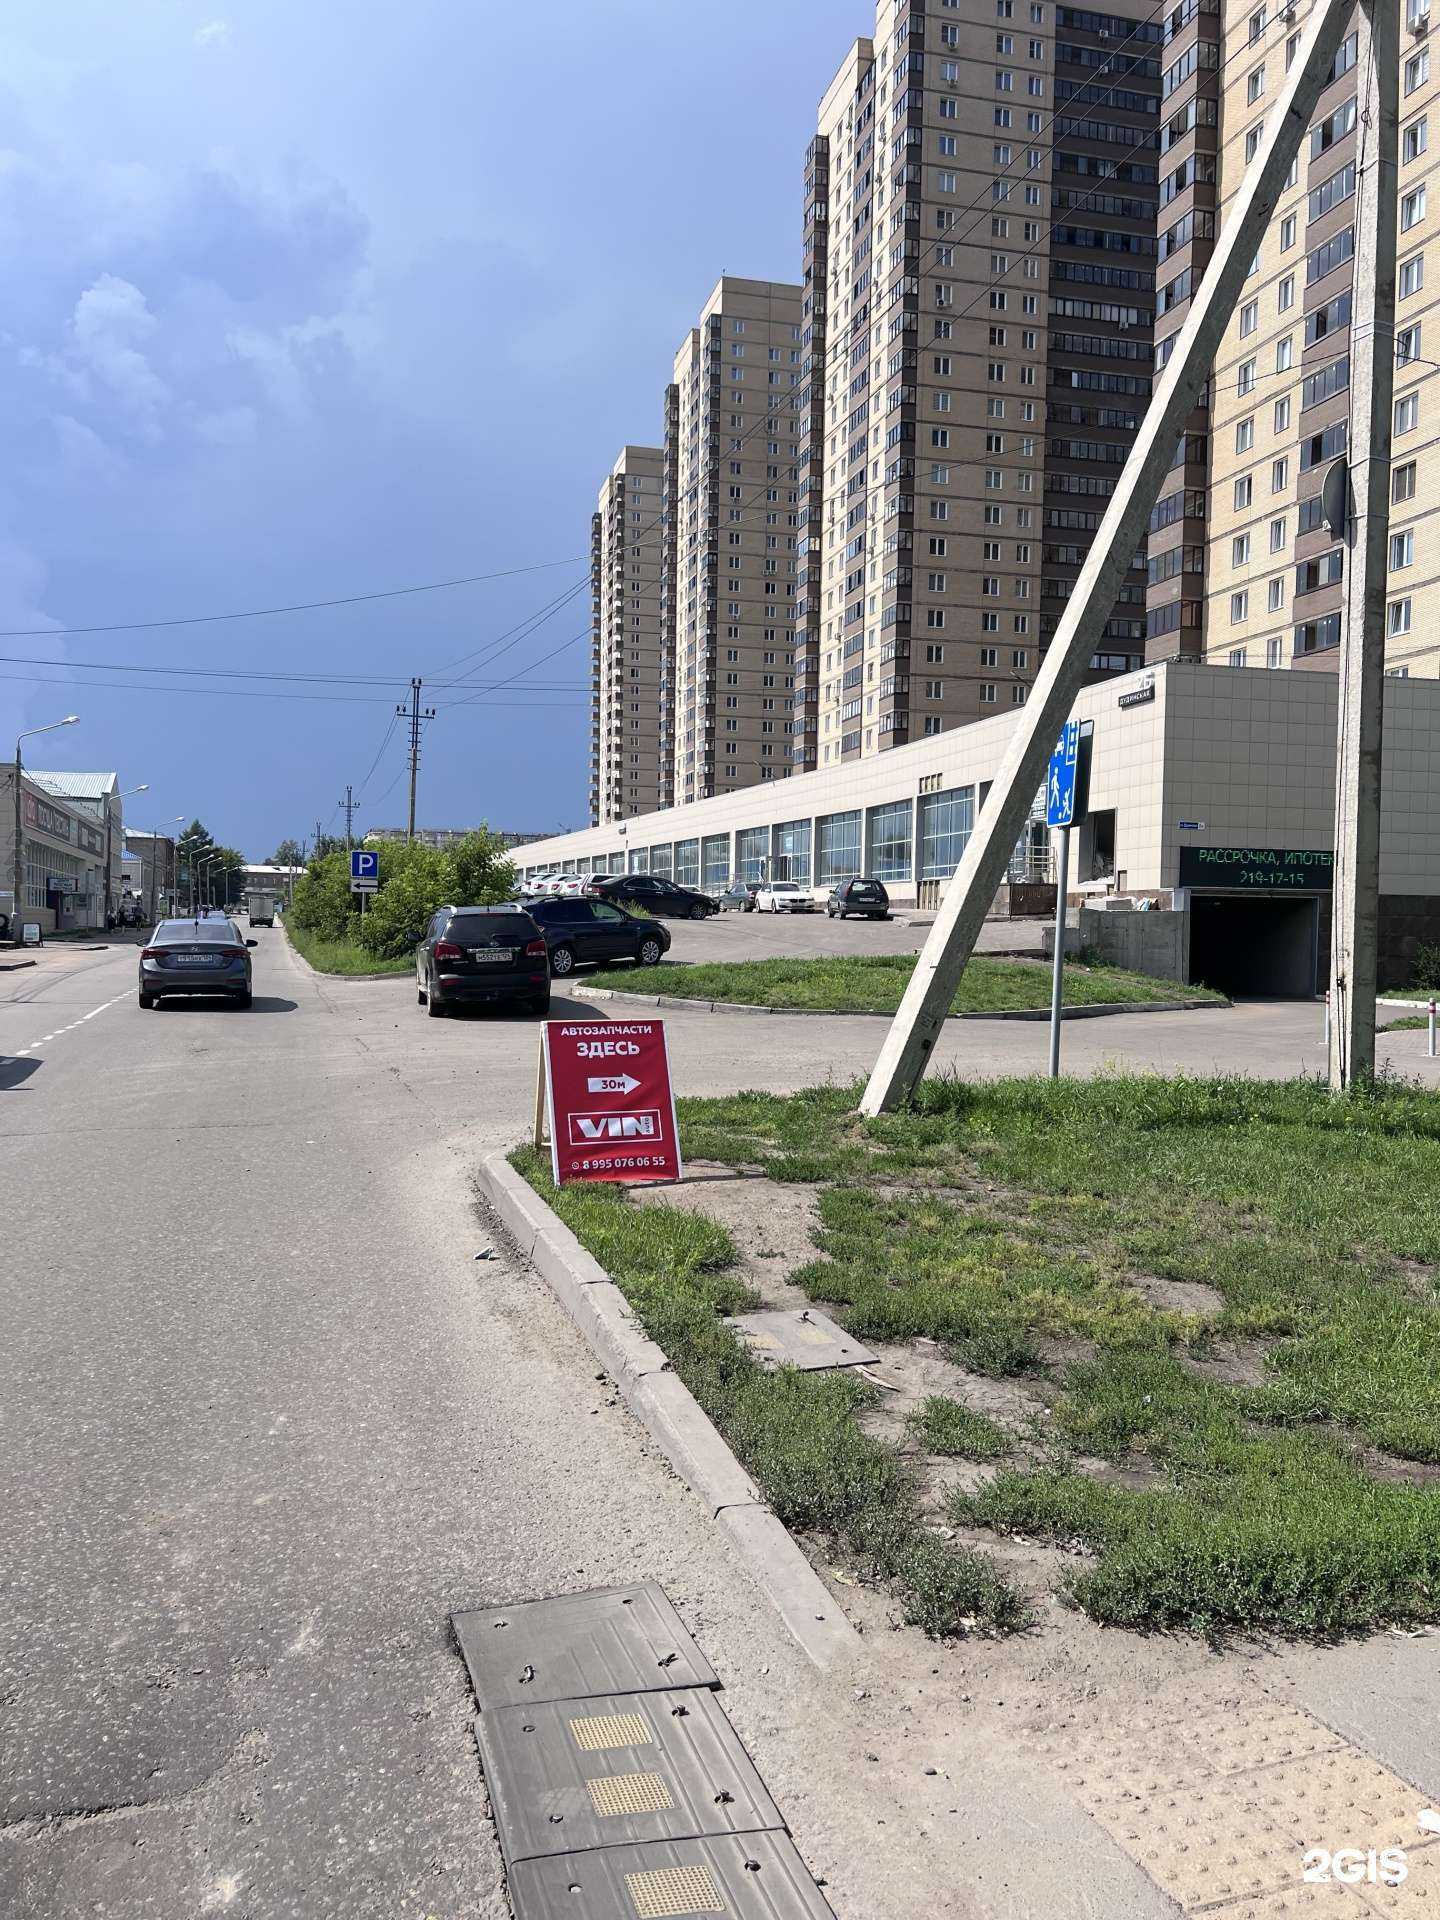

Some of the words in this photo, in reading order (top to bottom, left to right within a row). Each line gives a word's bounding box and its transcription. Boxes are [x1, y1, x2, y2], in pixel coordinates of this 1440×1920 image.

[359, 854, 374, 874] P
[1199, 848, 1280, 866] РАССРОЧКА,
[561, 1025, 652, 1036] АВТОЗАПЧАСТИ
[576, 1041, 641, 1059] ЗДЕСЬ
[601, 1079, 626, 1090] 30м
[576, 1115, 655, 1138] VIN
[582, 1160, 590, 1169] 8
[592, 1159, 612, 1169] 995
[614, 1157, 635, 1168] 076
[636, 1156, 650, 1167] 06
[652, 1156, 666, 1166] 55
